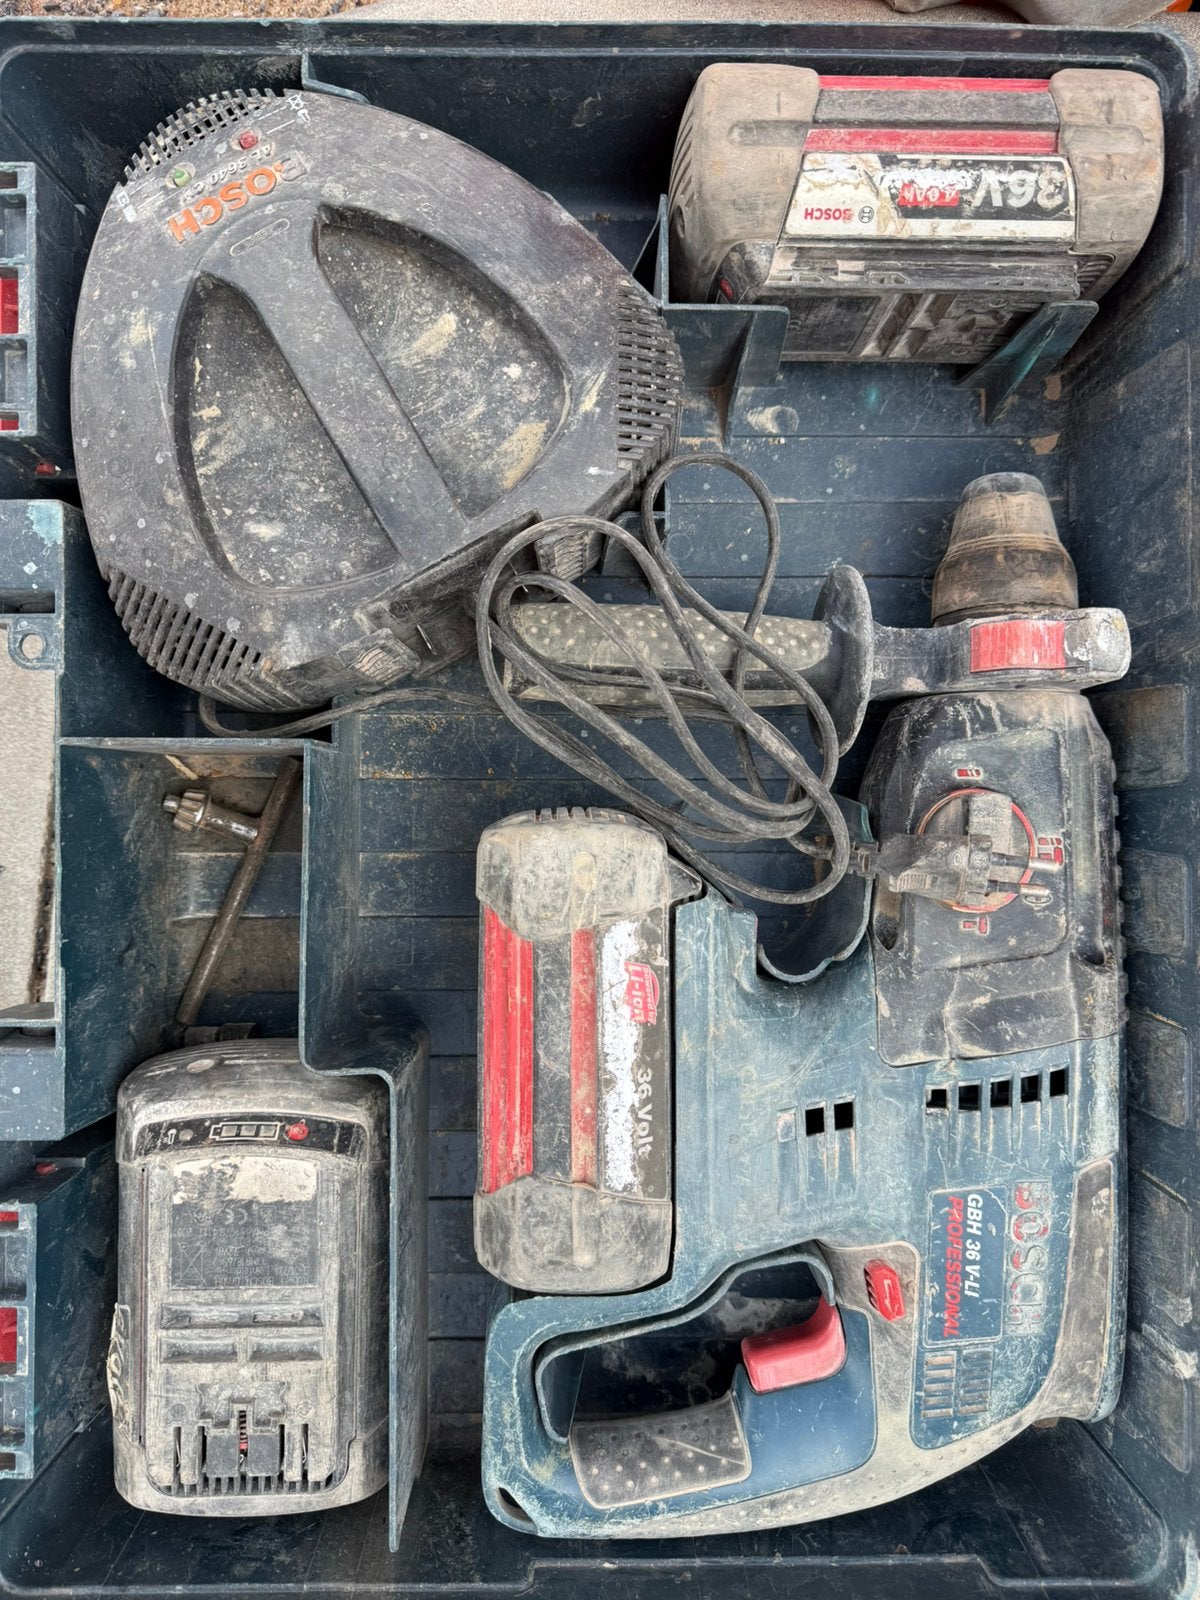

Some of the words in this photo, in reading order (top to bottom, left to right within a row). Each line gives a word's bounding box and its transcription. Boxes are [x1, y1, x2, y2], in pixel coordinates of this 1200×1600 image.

[207, 157, 248, 186] 3640
[166, 152, 307, 244] BOSCH
[803, 206, 853, 225] BOSCH
[629, 965, 643, 1022] Li-ion
[637, 1068, 653, 1099] 36
[636, 1103, 655, 1160] Volt
[966, 1193, 984, 1236] GBH
[943, 1195, 964, 1339] PROFESSIONAL
[965, 1239, 981, 1261] 36
[1007, 1181, 1051, 1335] BOSCH
[964, 1264, 980, 1298] V-LI
